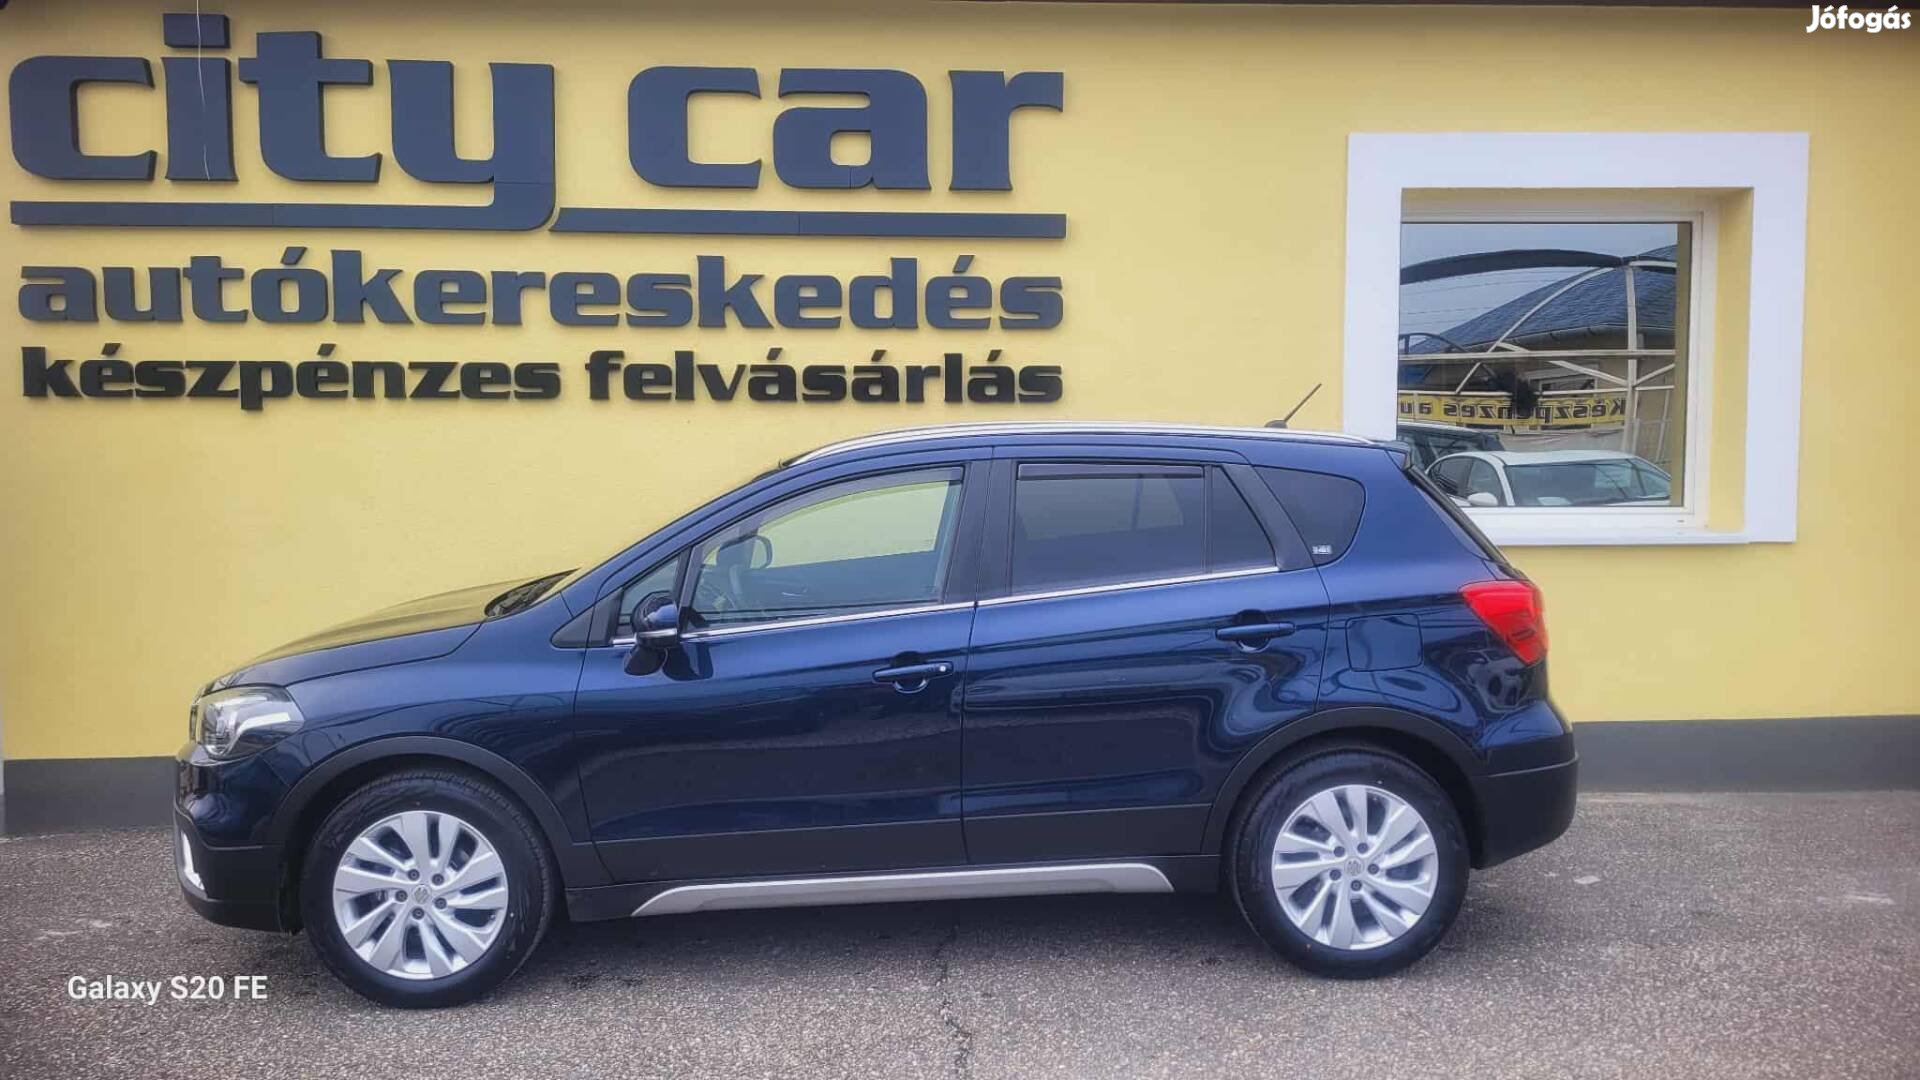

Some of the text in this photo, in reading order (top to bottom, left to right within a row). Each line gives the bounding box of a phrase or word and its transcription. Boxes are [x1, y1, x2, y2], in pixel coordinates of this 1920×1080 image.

[9, 13, 1064, 231] city car
[18, 246, 1064, 330] autókereskedés
[21, 343, 1063, 411] készpénzes felvásárlás
